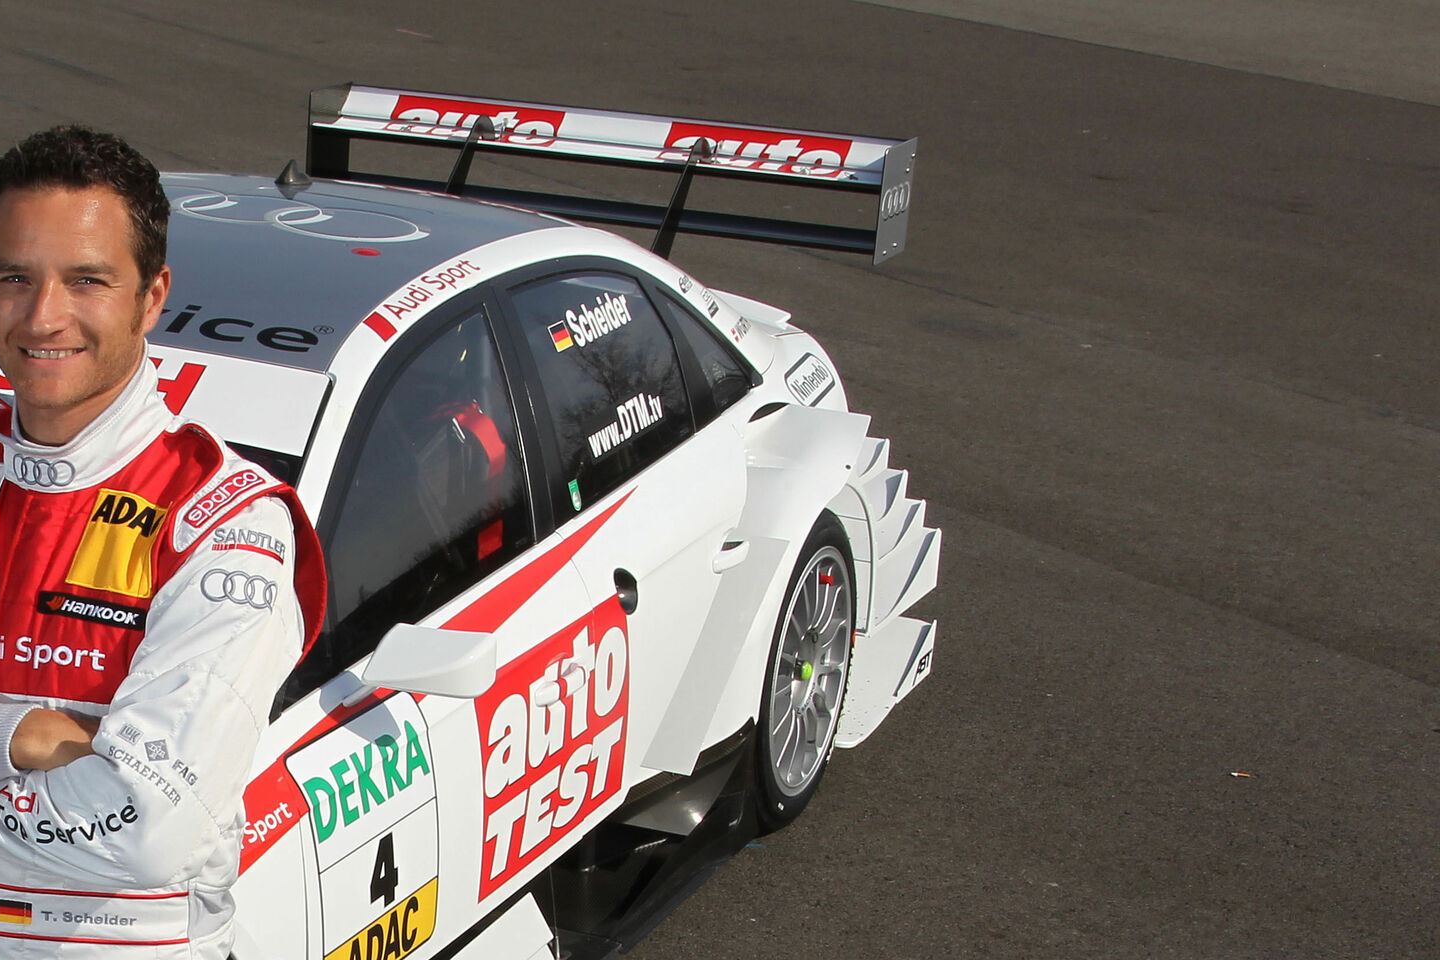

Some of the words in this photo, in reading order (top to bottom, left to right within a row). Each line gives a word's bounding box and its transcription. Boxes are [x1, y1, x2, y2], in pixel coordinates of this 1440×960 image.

[383, 276, 433, 320] Audi
[424, 259, 481, 290] Sport
[565, 292, 633, 349] Scheider
[790, 362, 829, 402] Nintendo
[587, 392, 665, 459] www.DTM.tv
[188, 472, 259, 522] sparco
[212, 528, 287, 557] SANDTLER
[14, 636, 106, 671] Sport
[485, 625, 627, 799] auto
[108, 745, 182, 807] SCHAEFFLER
[172, 758, 199, 787] FAG
[303, 719, 431, 844] DEKRA
[484, 716, 625, 880] TEST
[35, 802, 139, 846] Service
[244, 802, 293, 844] Sport
[369, 832, 399, 908] 4
[40, 910, 57, 926] T.
[62, 909, 138, 927] Scheider
